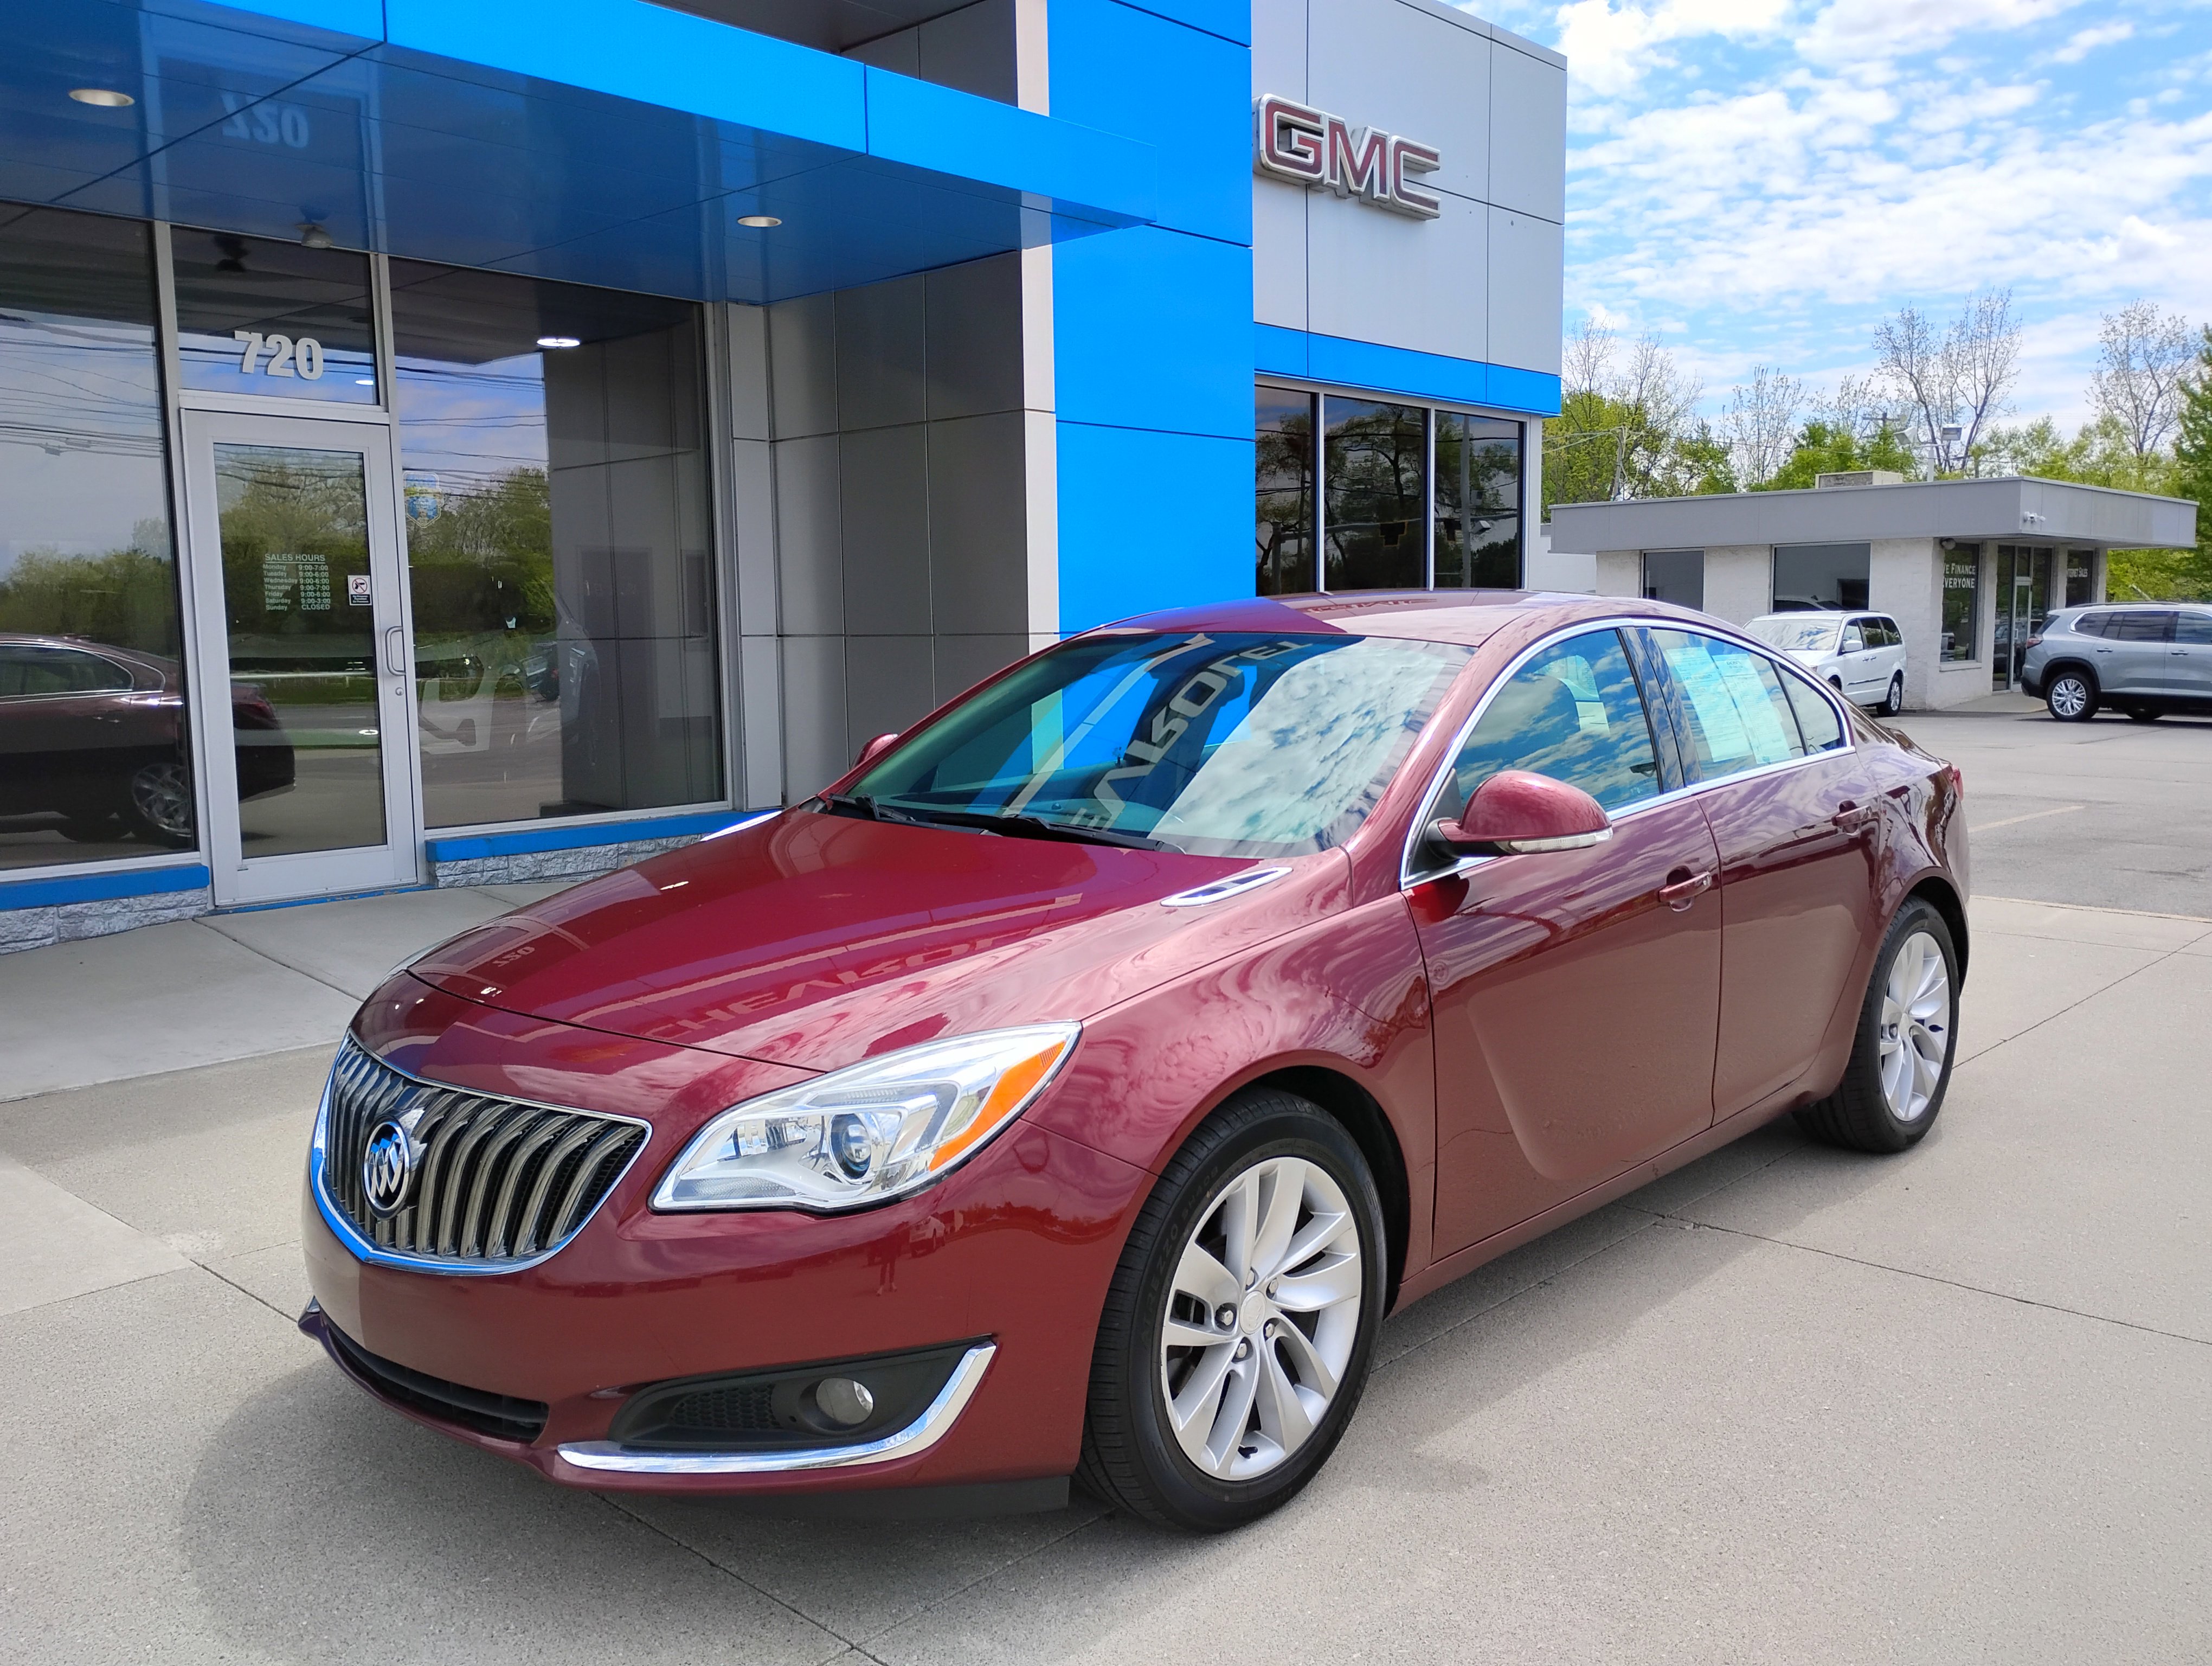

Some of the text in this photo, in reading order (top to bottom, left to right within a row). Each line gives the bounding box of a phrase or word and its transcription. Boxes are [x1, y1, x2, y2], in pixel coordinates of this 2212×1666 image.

[1255, 93, 1441, 220] GMC
[235, 330, 324, 380] 720
[1943, 563, 1976, 574] E FINANCE
[1943, 577, 1975, 588] VERYONE
